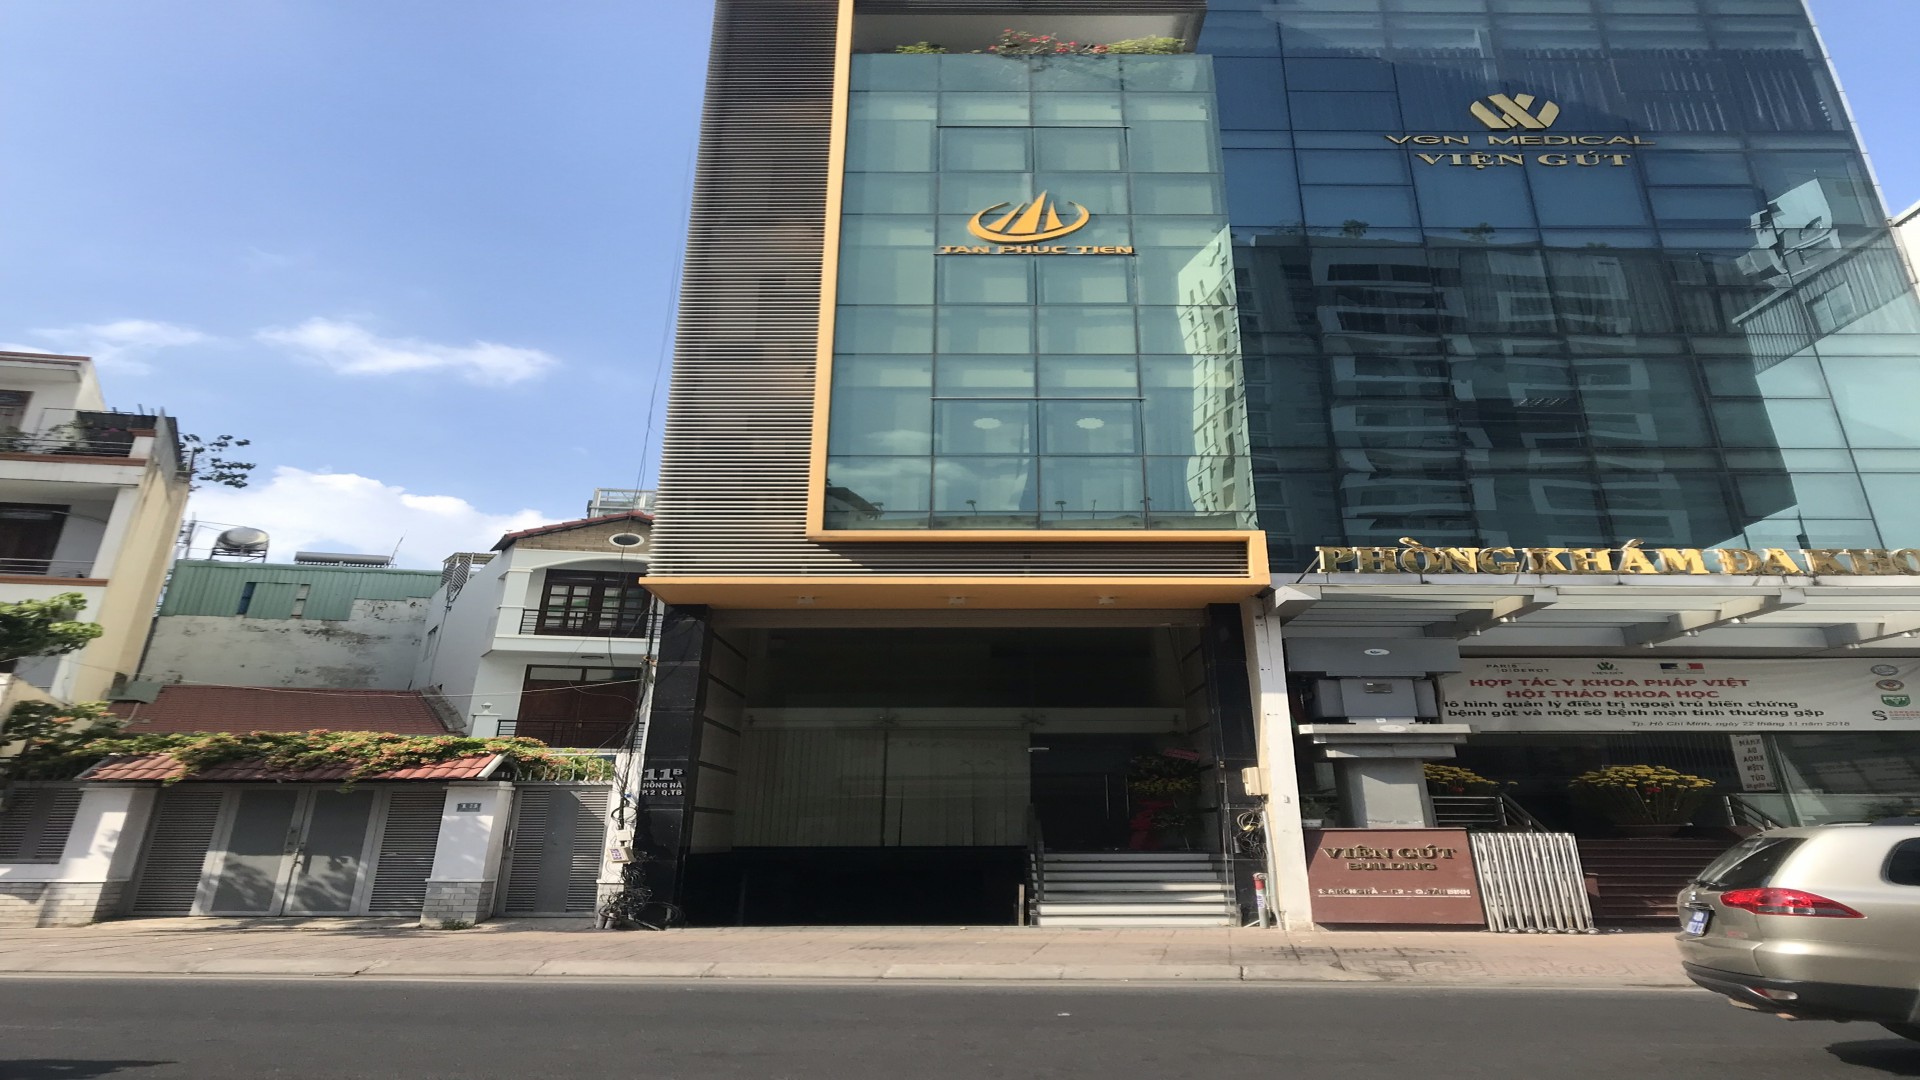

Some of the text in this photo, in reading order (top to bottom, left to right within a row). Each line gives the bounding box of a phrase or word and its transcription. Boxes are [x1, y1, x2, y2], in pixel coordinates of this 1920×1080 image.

[1385, 135, 1656, 145] VGN MEDICAL
[1416, 150, 1632, 169] VIỆN GÚT
[1315, 536, 1920, 576] PHÒNG KHÁM ĐA KHO
[1470, 677, 1750, 688] HỢP TÁC Y KHOA PHÁP VIỆT
[1506, 688, 1720, 699] HỘI THẢO KHOA HỌC
[1464, 700, 1498, 708] hình
[1503, 701, 1543, 709] quản
[1548, 701, 1561, 709] lý
[1567, 700, 1601, 708] điều
[1607, 701, 1625, 709] trị
[1631, 701, 1675, 709] ngoại
[1680, 700, 1703, 708] trú
[1708, 700, 1743, 708] biến
[1748, 700, 1799, 709] chứng
[1448, 709, 1487, 717] bệnh
[1491, 709, 1519, 717] gút
[1547, 709, 1581, 717] một
[1607, 709, 1648, 717] bệnh
[1729, 709, 1789, 717] thường
[1793, 709, 1824, 717] gặp
[643, 768, 683, 780] 11B
[642, 780, 683, 788] HỒNG HÀ
[1321, 843, 1457, 861] VIỆN GÚT
[1346, 862, 1438, 871] BUILDING
